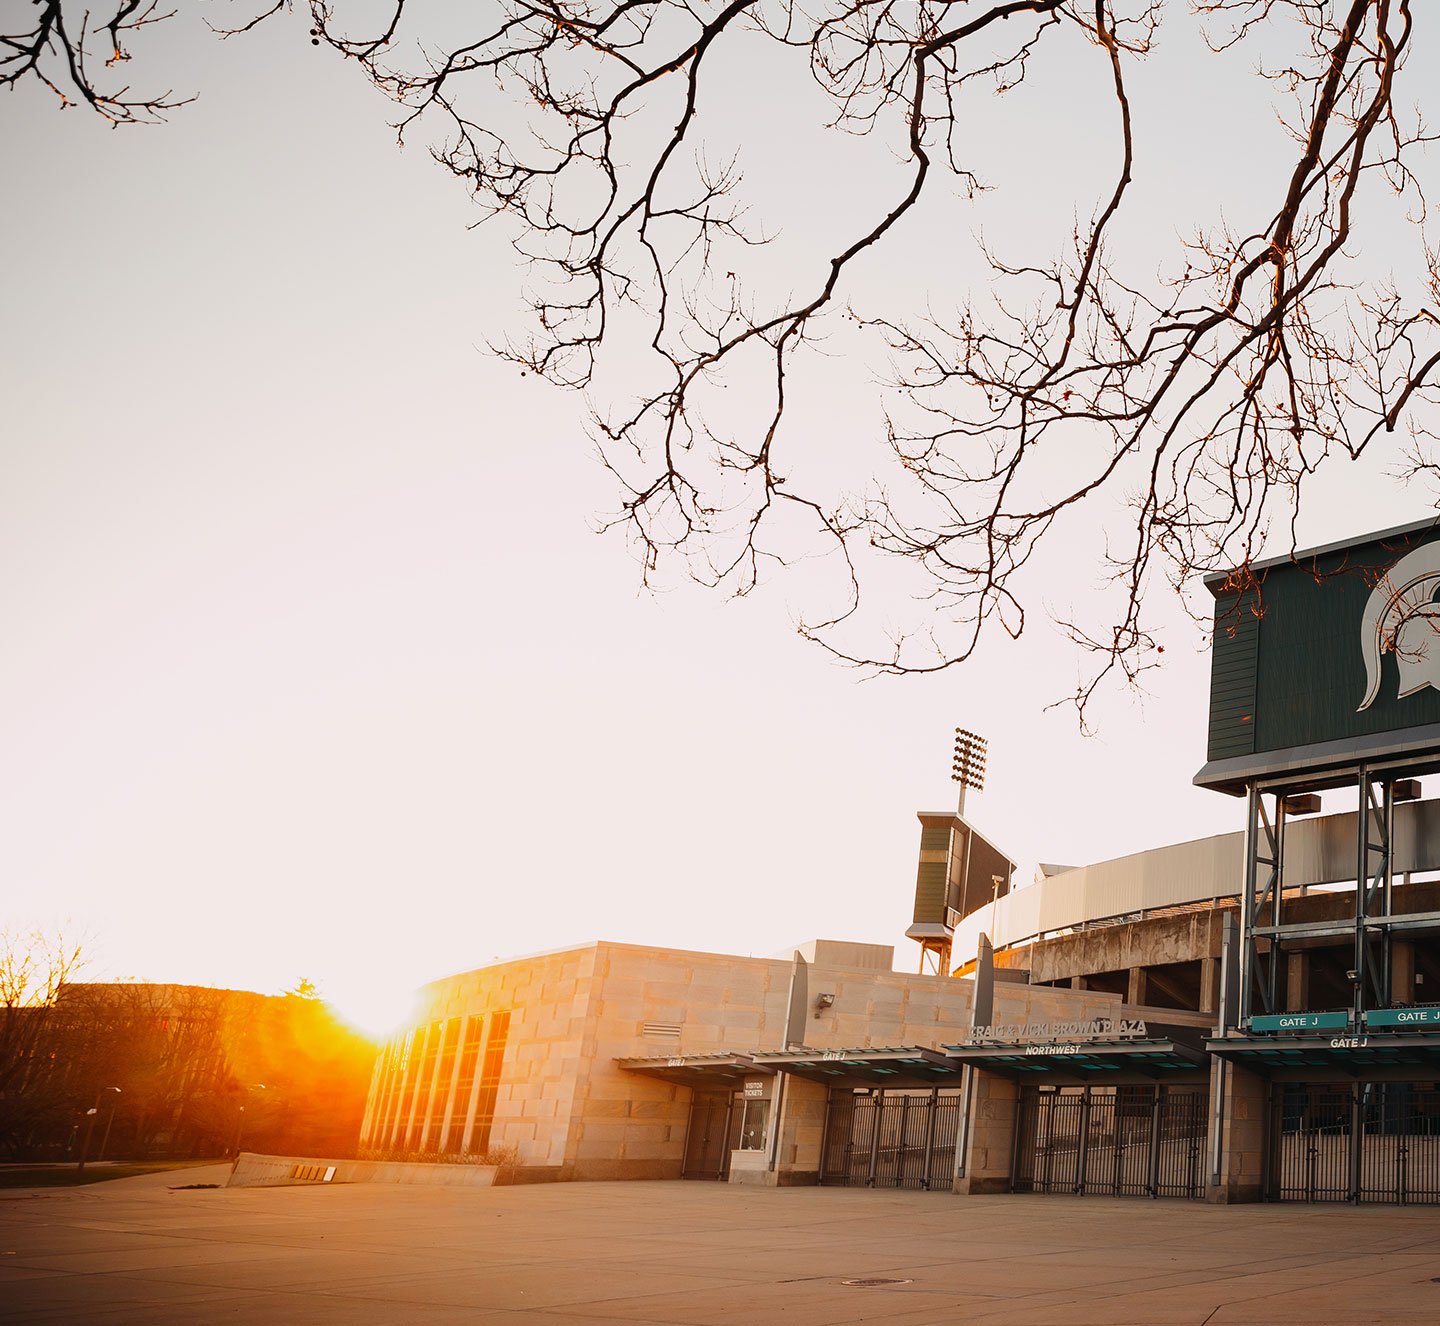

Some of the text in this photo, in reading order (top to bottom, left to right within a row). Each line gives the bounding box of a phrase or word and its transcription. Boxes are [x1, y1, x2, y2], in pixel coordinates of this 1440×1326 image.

[1397, 1011, 1440, 1021] GATE J
[1279, 1017, 1318, 1027] GATE J
[971, 1020, 1147, 1038] CRAIG & VICKI BROWN PLAZA
[1330, 1038, 1368, 1048] GATE J
[1025, 1045, 1081, 1056] NORTHWEST
[823, 1053, 840, 1061] GATE
[745, 1089, 763, 1097] TICKETS
